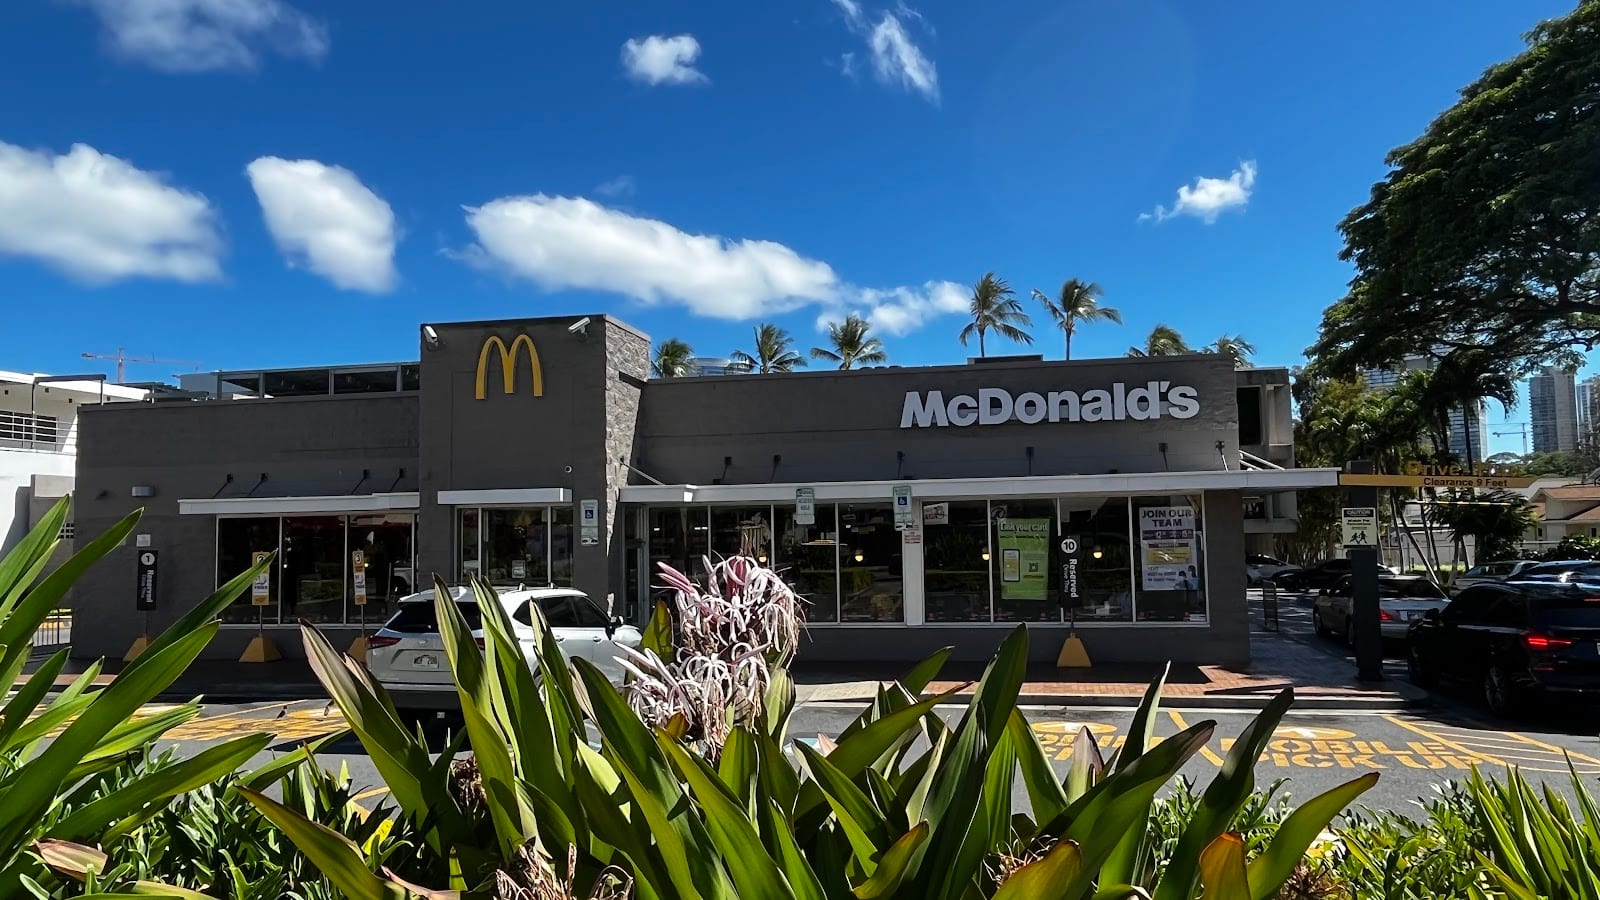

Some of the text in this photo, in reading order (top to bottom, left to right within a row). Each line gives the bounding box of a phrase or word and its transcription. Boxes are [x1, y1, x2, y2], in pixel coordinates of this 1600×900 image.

[900, 381, 1200, 428] McDonald's
[1423, 478, 1508, 487] Clearance 9 Feet
[1142, 509, 1193, 519] JOIN OUR
[1152, 519, 1182, 527] TEAM
[1063, 540, 1075, 551] 10
[1069, 558, 1079, 598] Reserved
[1394, 753, 1484, 769] UP
